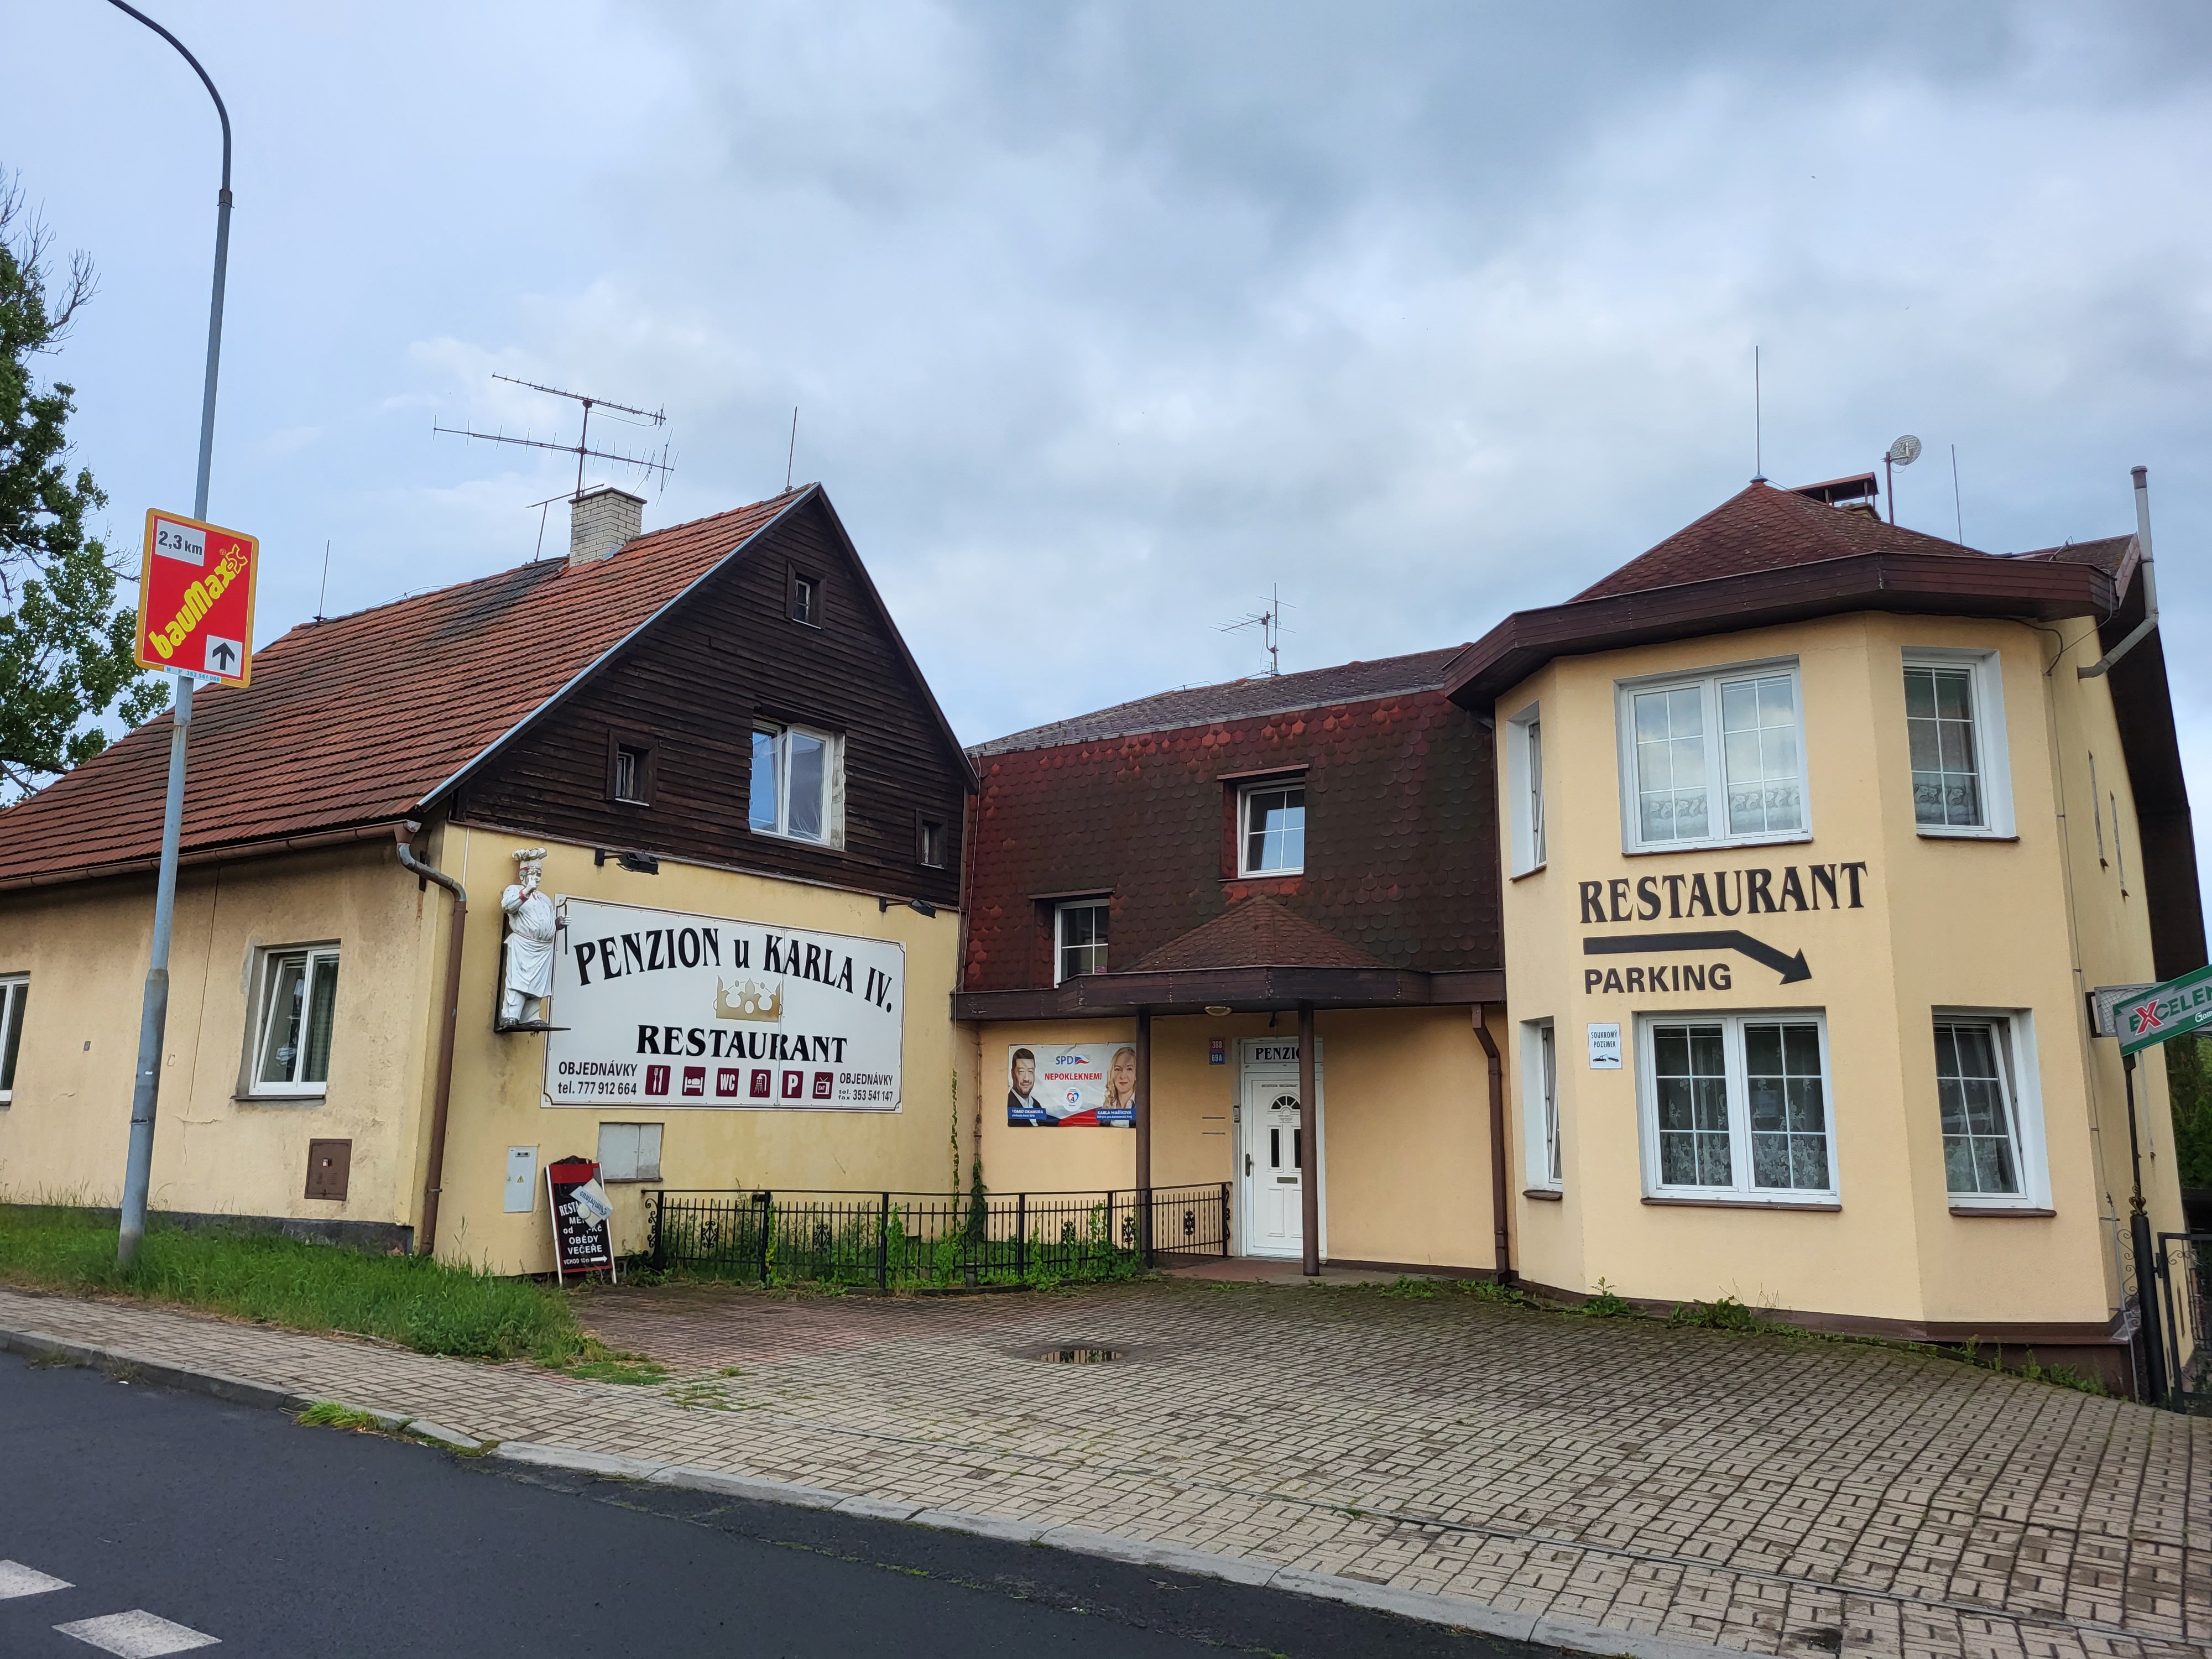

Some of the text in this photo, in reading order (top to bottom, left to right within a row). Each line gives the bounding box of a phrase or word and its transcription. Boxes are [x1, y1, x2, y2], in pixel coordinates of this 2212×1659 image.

[158, 530, 202, 556] 2,3 km
[1578, 860, 1868, 924] RESTAURANT
[573, 926, 893, 1013] PENZION u KARLA IV.
[1584, 963, 1731, 995] PARKING
[1590, 1029, 1618, 1039] SOUKROMÝ
[637, 1024, 848, 1063] RESTAURANT
[1055, 1055, 1073, 1065] SPD
[1212, 1053, 1222, 1062] 69A
[559, 1060, 638, 1077] OBJEDNÁVKY
[719, 1073, 736, 1092] WC
[839, 1071, 893, 1086] OBJEDNÁVKY
[1044, 1072, 1102, 1081] NEPOKLEKNEM!
[557, 1080, 637, 1095] tel. 777 912 664
[787, 1074, 799, 1095] P
[853, 1089, 893, 1102] 353 541 147
[563, 1226, 573, 1234] od
[568, 1234, 598, 1245] OBĚDY
[567, 1243, 603, 1255] VEČEŘE
